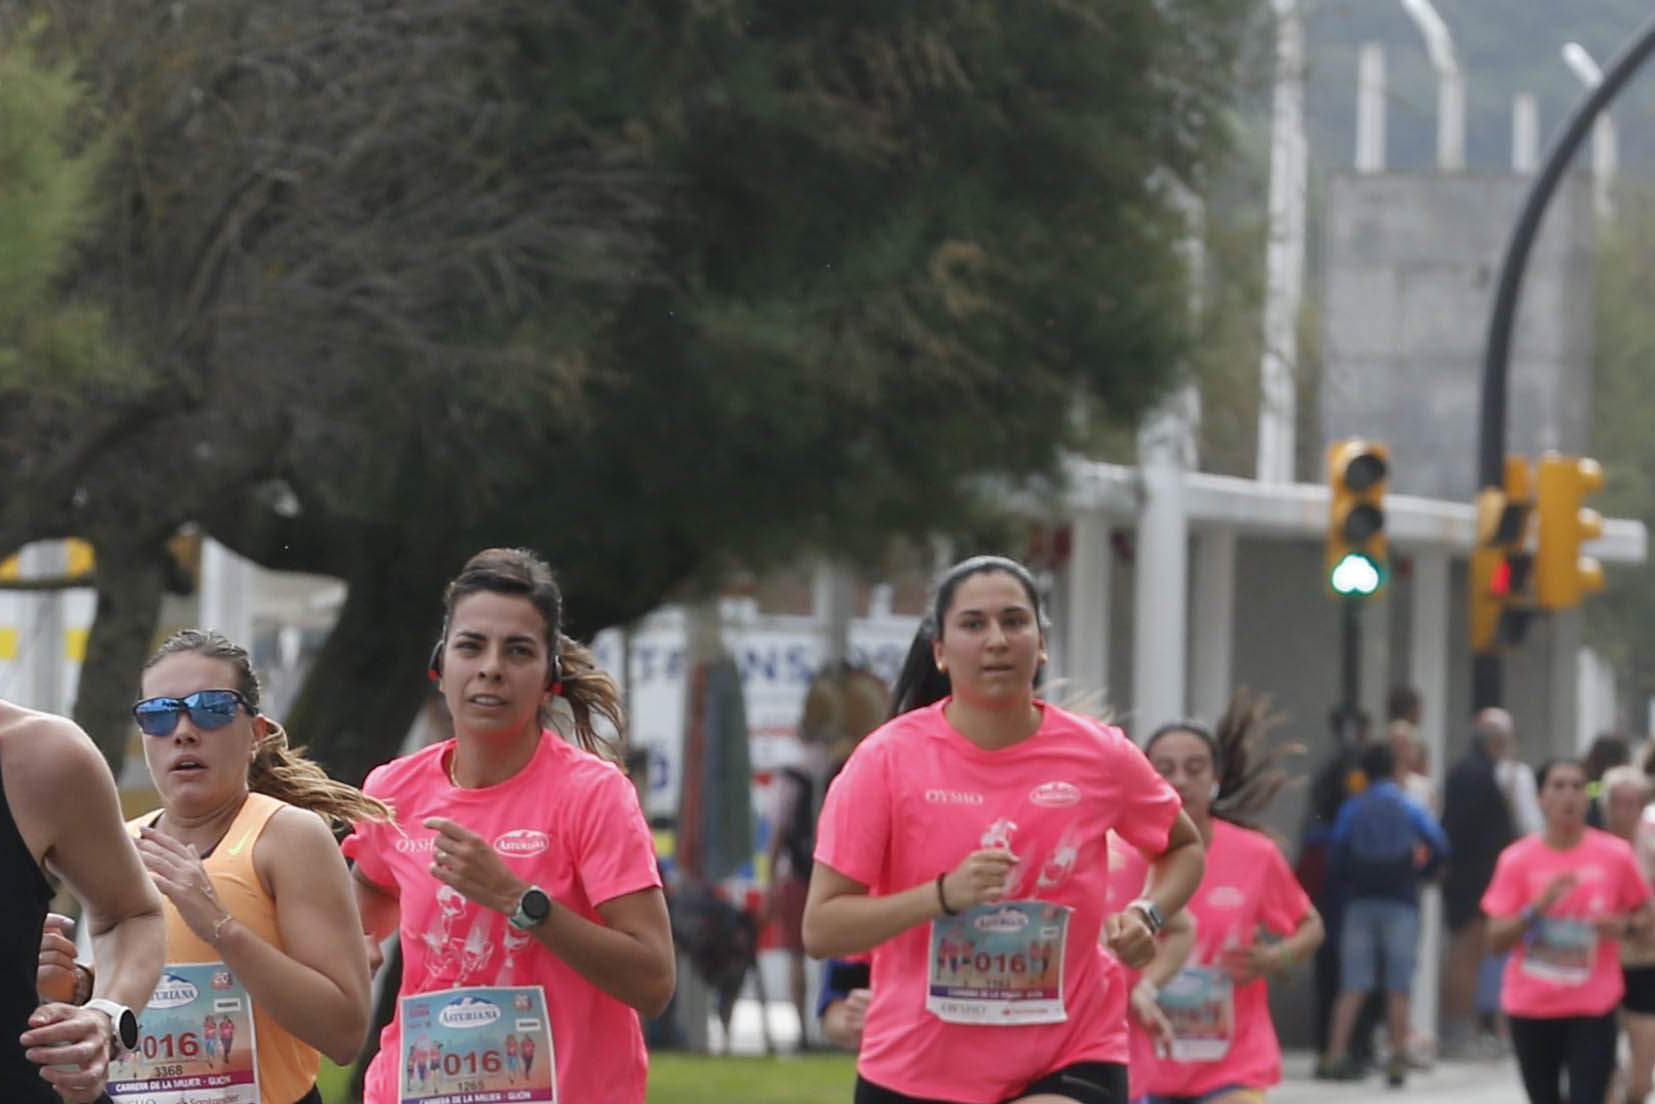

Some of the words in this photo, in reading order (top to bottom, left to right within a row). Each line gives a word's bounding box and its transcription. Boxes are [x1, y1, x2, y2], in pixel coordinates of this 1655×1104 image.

[395, 838, 435, 854] OYSH
[975, 952, 1026, 973] 016
[143, 1032, 200, 1059] 016
[443, 1050, 502, 1076] 016
